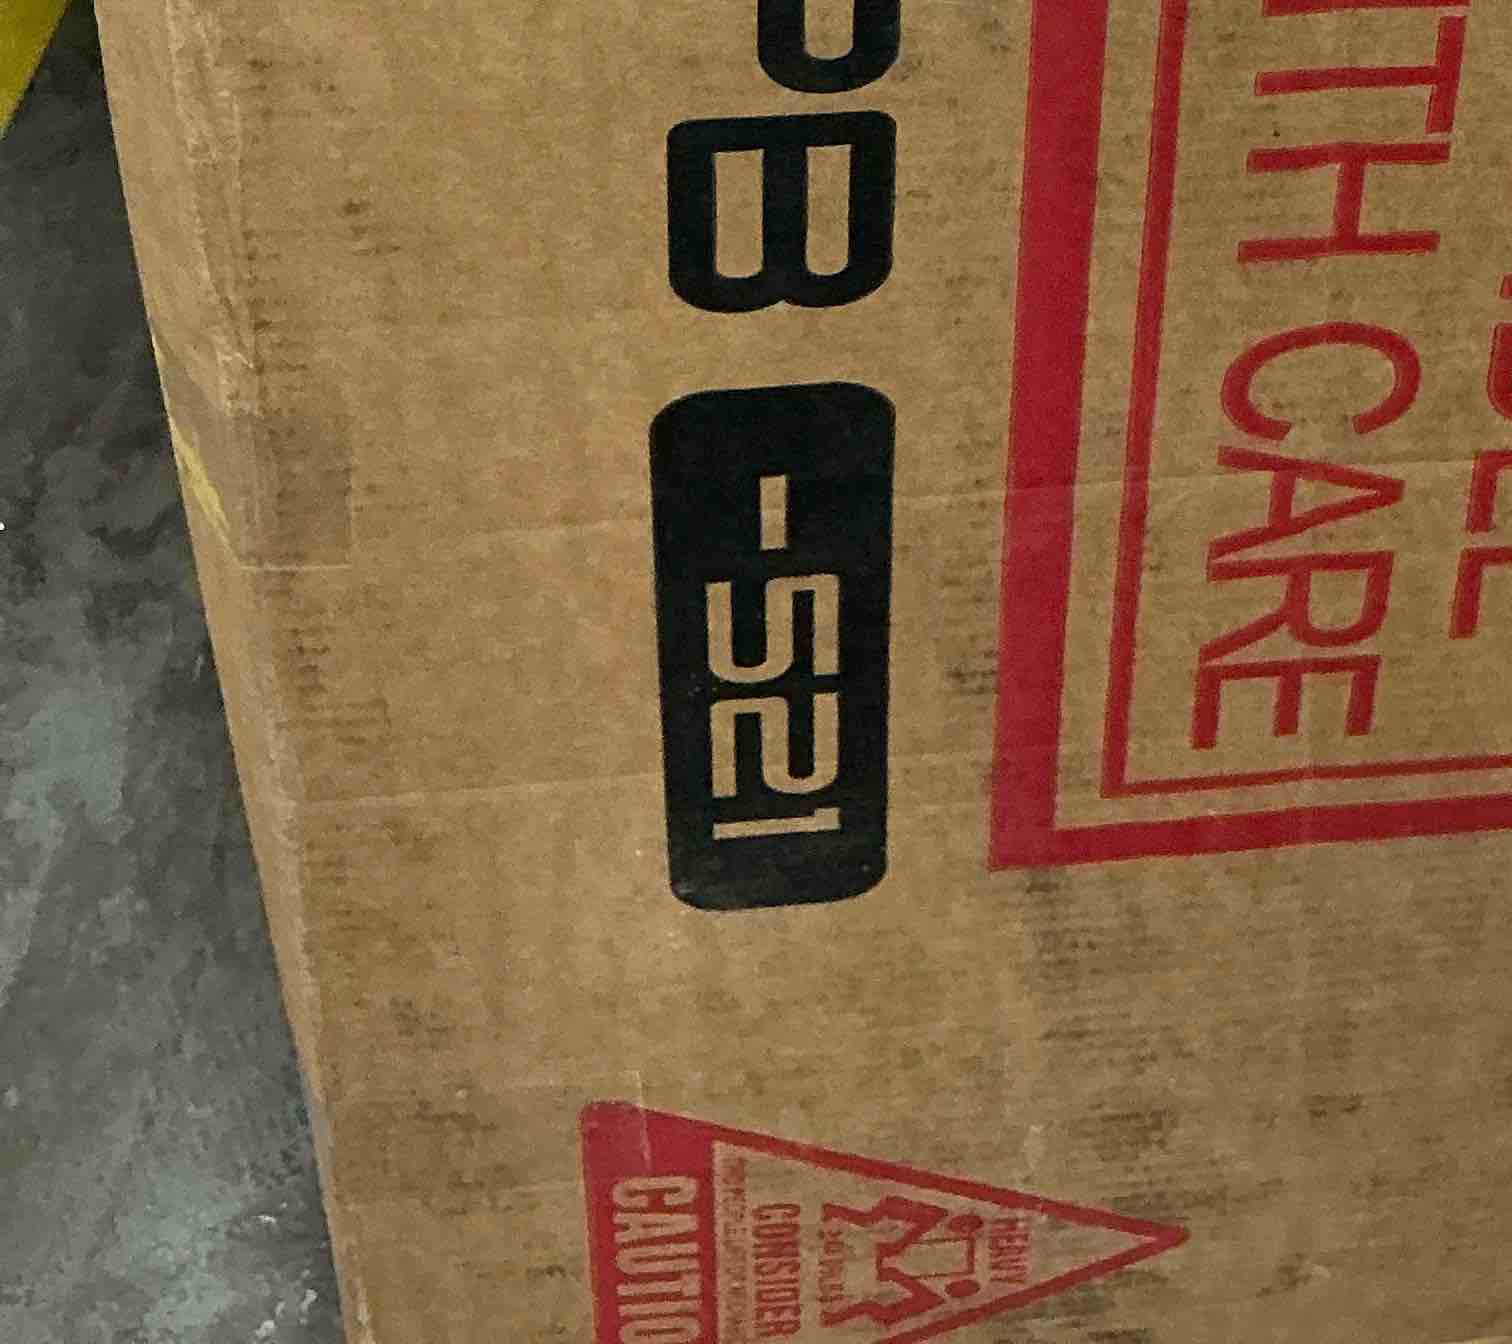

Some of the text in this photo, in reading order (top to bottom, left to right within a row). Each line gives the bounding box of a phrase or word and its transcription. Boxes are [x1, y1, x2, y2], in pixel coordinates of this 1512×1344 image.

[1190, 321, 1426, 750] CARE
[752, 1202, 801, 1338] CONSIDER
[986, 1216, 1029, 1284] HEAVY
